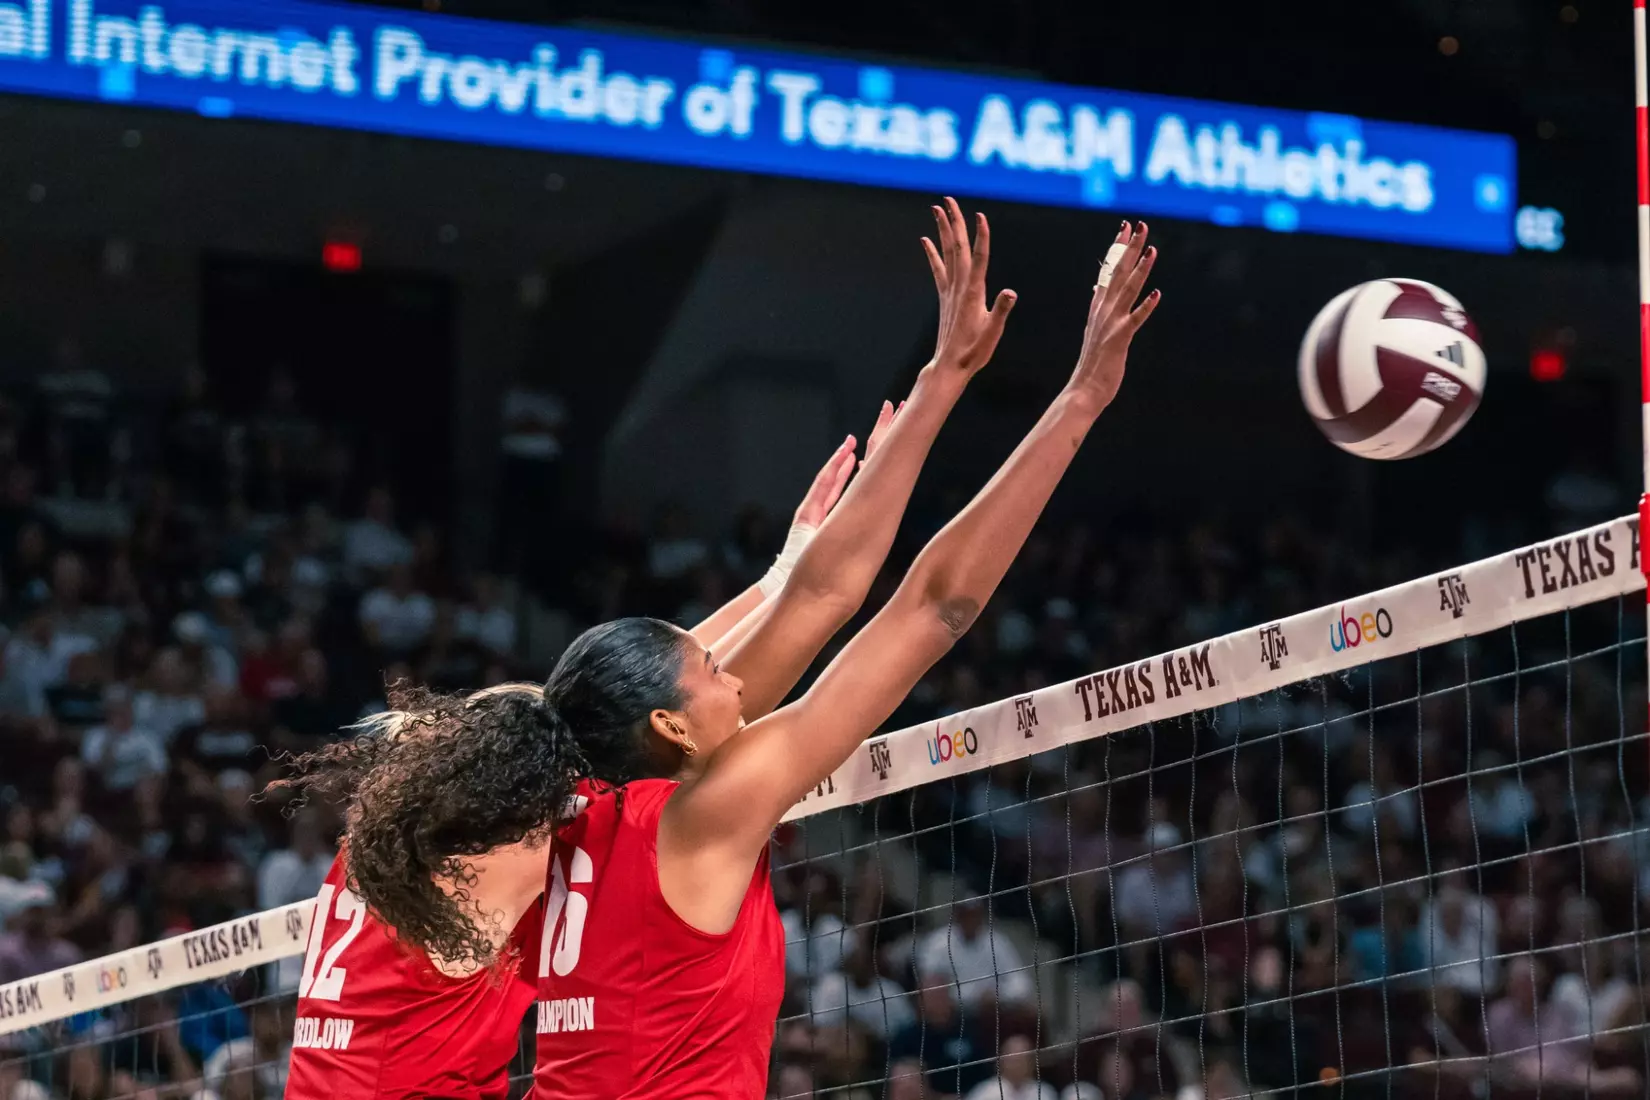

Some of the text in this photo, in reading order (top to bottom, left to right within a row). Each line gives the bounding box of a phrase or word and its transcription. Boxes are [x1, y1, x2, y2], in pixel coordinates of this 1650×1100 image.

[68, 0, 359, 92] Internet
[374, 26, 673, 126] Provider
[684, 66, 757, 138] of
[766, 71, 958, 159] Texas
[968, 95, 1134, 181] A&M
[1145, 114, 1433, 213] Athletics
[1516, 527, 1615, 599] TEXAS
[1330, 605, 1393, 652] ubeo
[1075, 660, 1155, 722] TEXAS
[927, 722, 978, 766] ubeo
[183, 928, 230, 969] TEXAS
[298, 884, 366, 1001] 12
[292, 1016, 355, 1050] RDLOW
[536, 996, 595, 1034] AMPION
